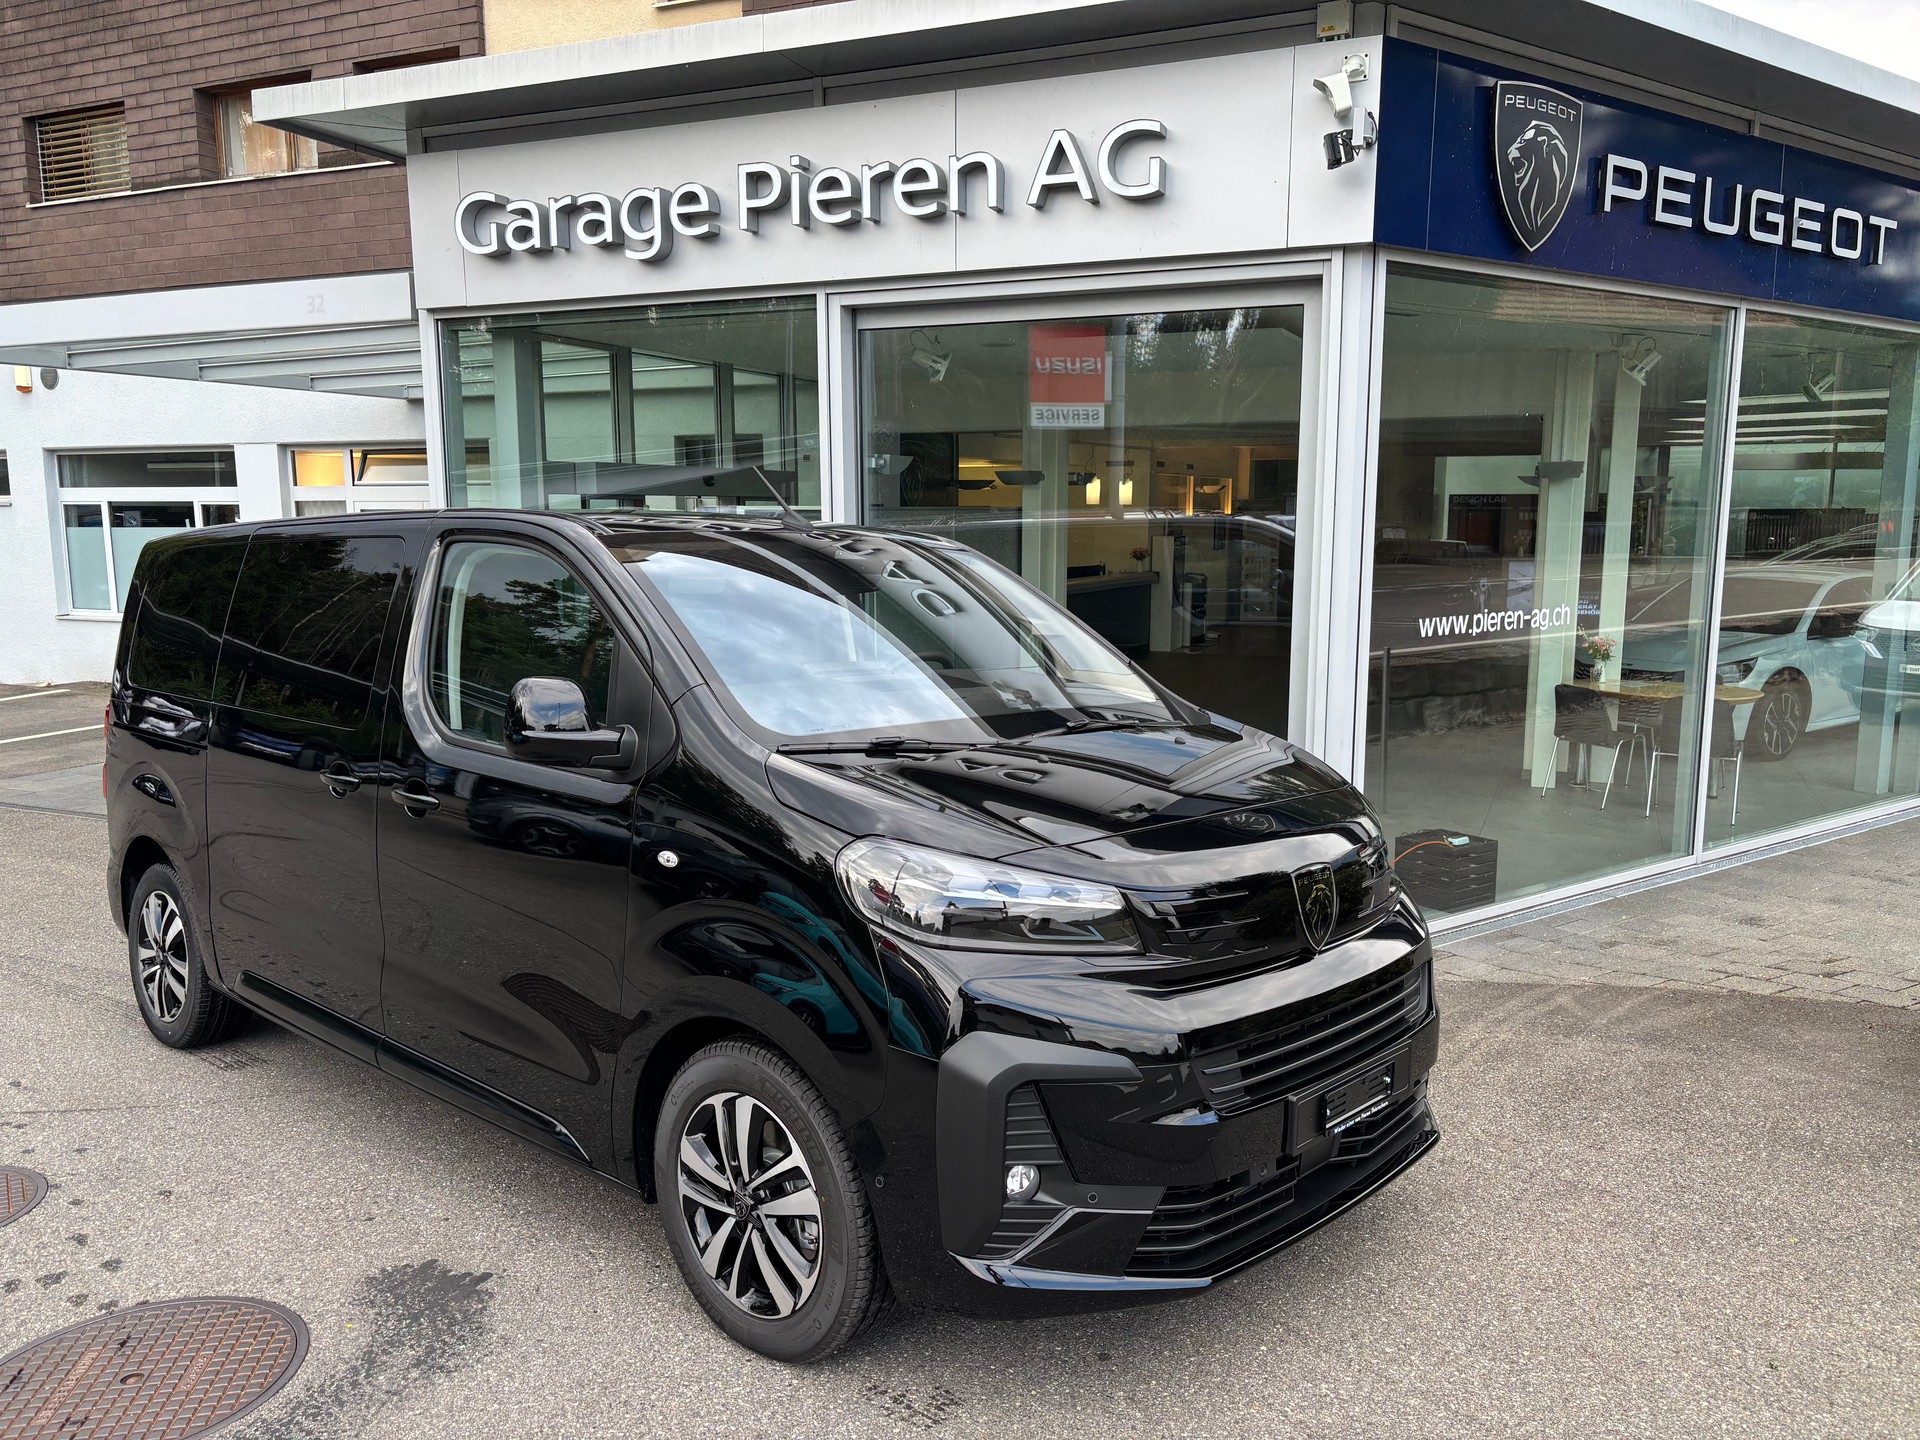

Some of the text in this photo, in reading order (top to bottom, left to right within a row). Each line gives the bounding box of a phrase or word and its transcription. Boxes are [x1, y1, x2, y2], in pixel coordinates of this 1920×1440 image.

[1504, 94, 1577, 122] PEUGEOT
[454, 117, 1168, 262] Garage Pieren AG
[1600, 153, 1898, 265] PEUGEOT
[306, 294, 326, 314] 32
[1419, 603, 1570, 638] www.pieren-ag.ch
[1298, 872, 1330, 887] PEUGEOT
